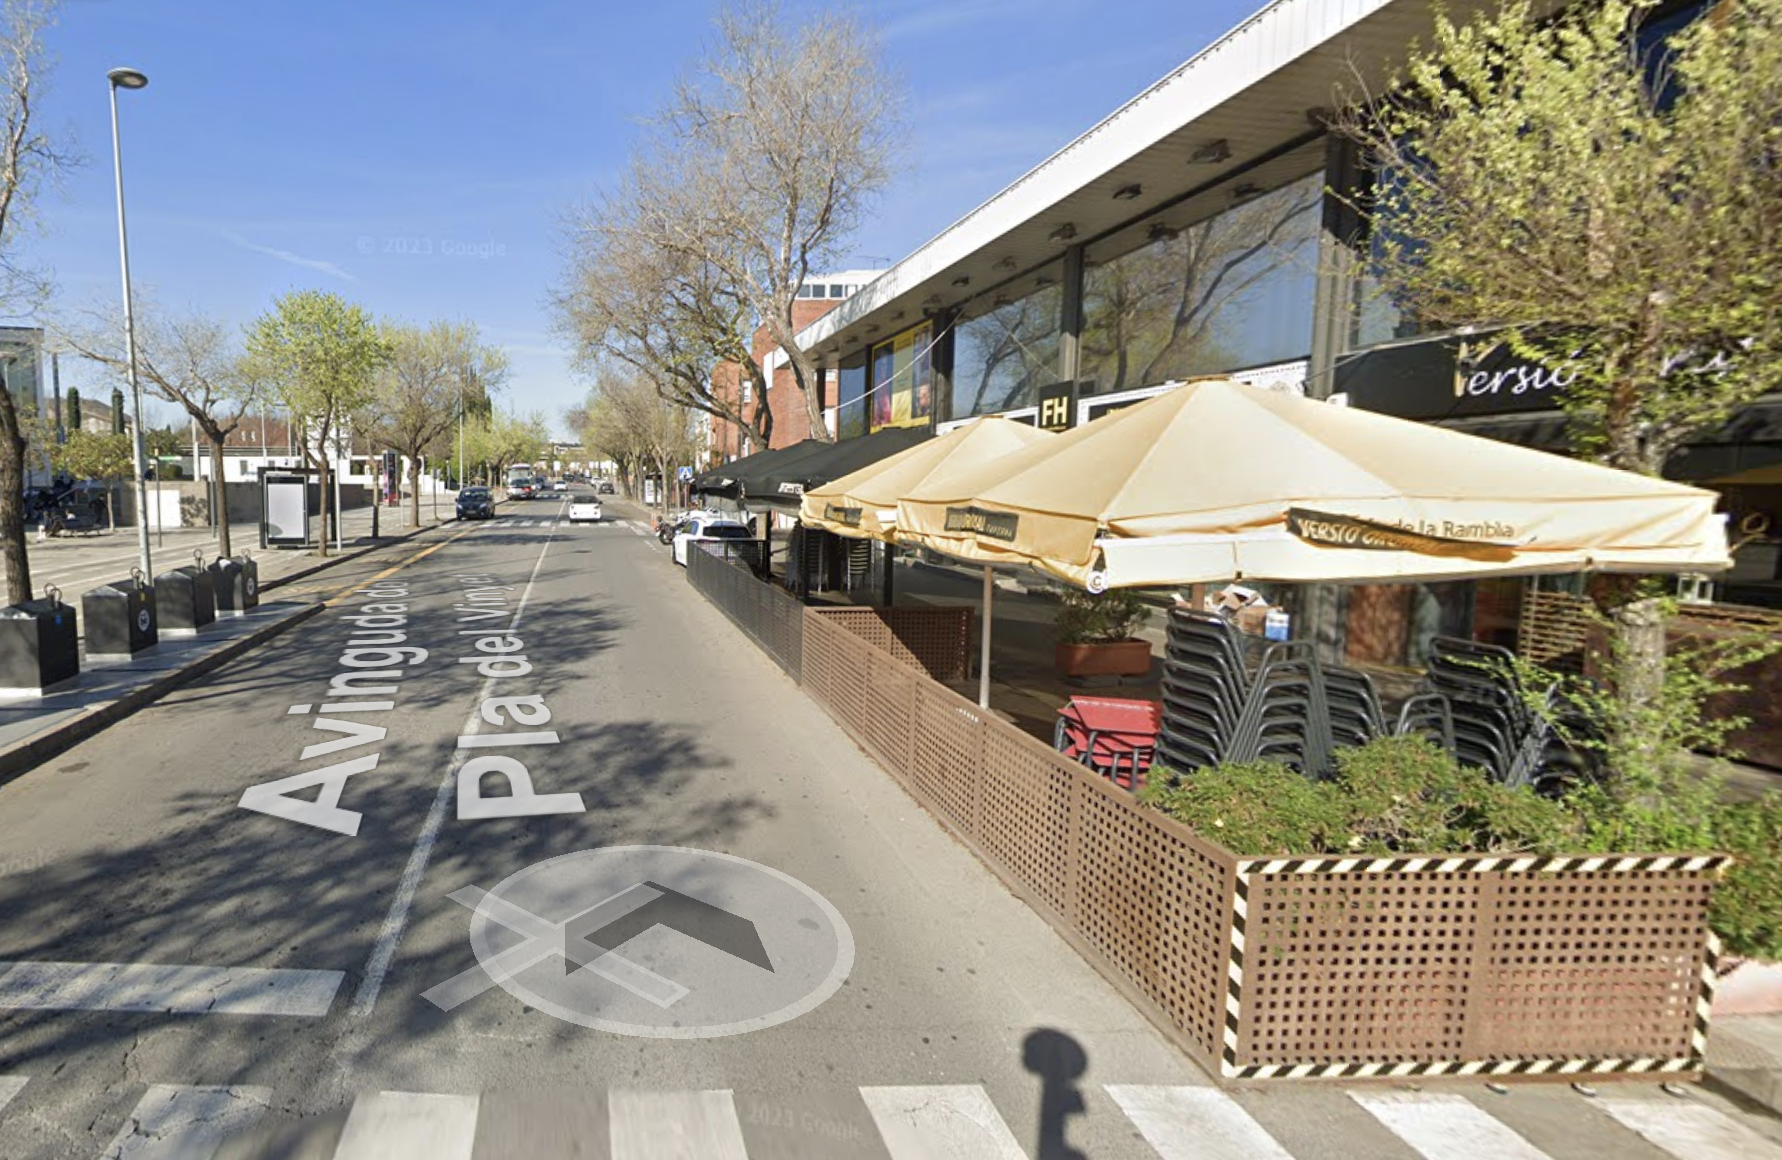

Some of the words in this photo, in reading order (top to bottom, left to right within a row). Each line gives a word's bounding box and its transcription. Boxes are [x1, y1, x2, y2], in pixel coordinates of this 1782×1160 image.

[1042, 396, 1068, 426] FH
[1419, 520, 1436, 535] la
[1443, 520, 1515, 537] Rambla
